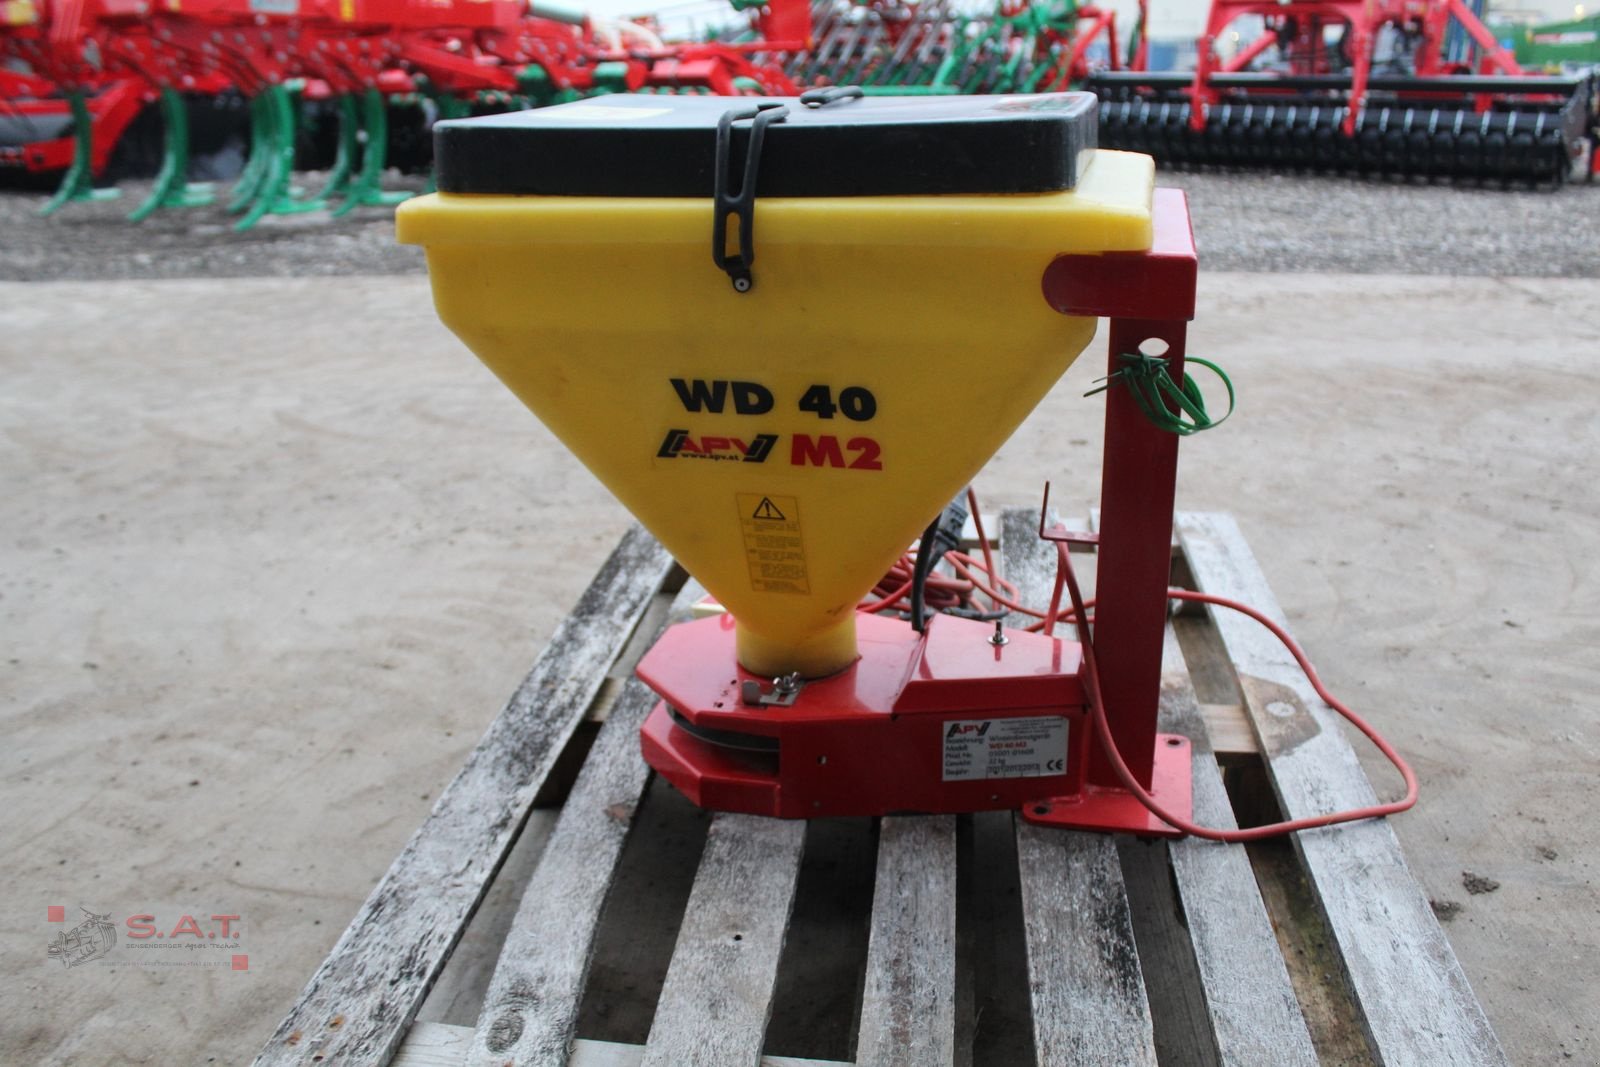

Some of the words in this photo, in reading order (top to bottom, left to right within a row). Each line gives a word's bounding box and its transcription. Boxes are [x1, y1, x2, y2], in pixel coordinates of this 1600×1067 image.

[669, 378, 775, 415] WD
[798, 384, 877, 422] 40
[790, 433, 883, 471] M2
